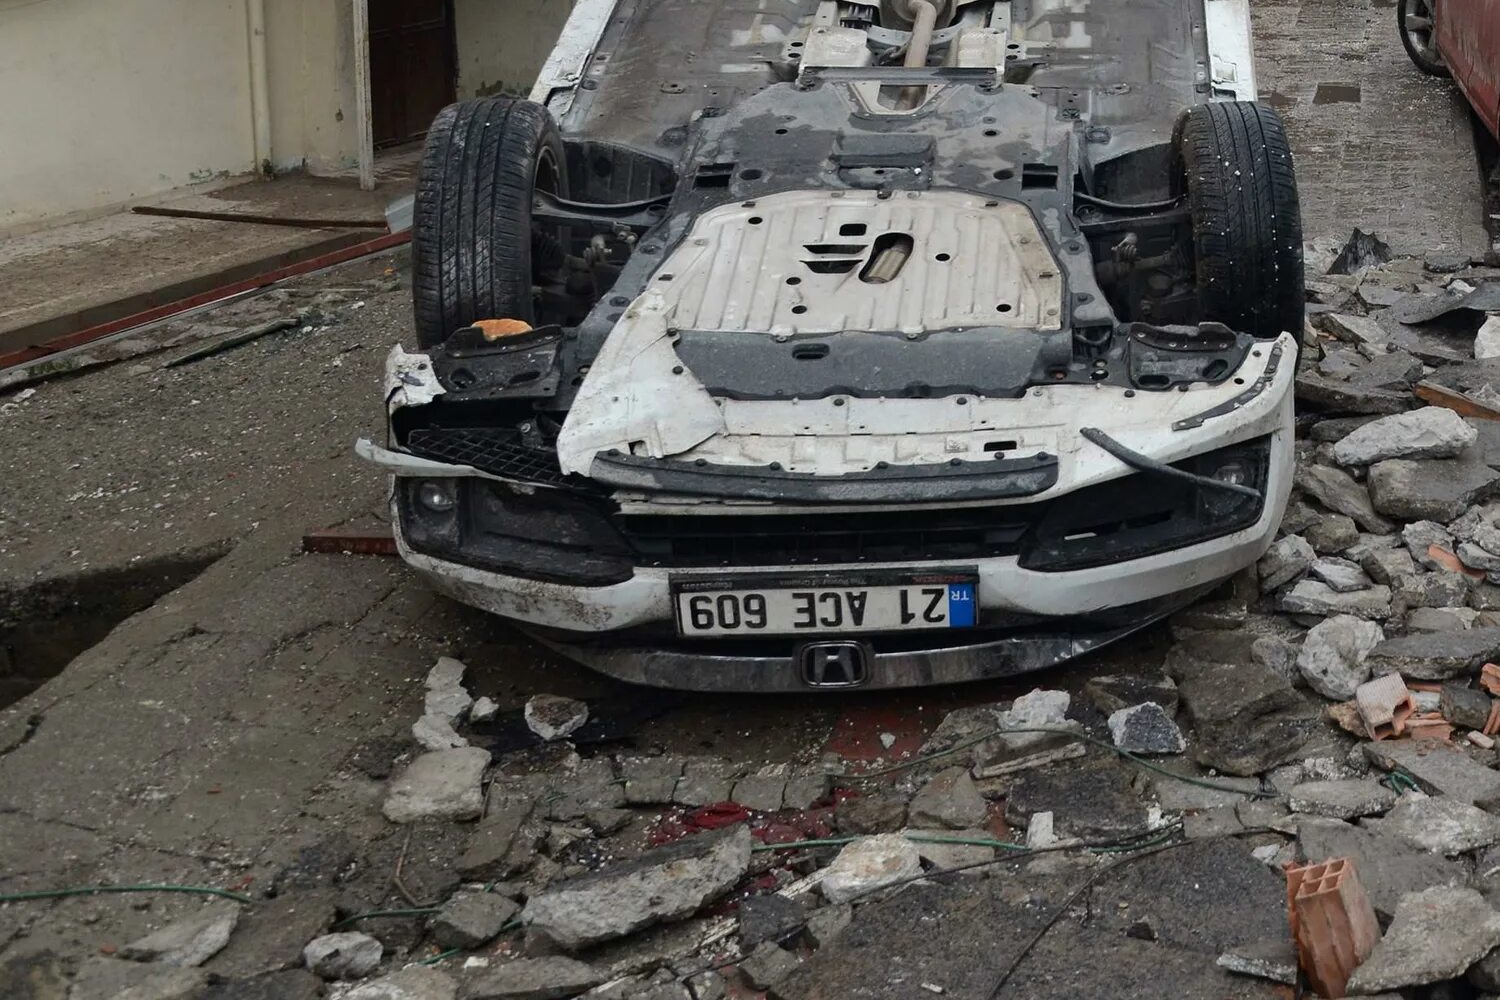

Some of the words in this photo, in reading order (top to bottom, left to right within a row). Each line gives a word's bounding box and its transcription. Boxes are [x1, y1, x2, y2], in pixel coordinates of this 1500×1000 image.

[689, 594, 768, 630] 609
[792, 591, 868, 628] ACE
[900, 588, 946, 625] 21
[951, 590, 970, 601] TR
